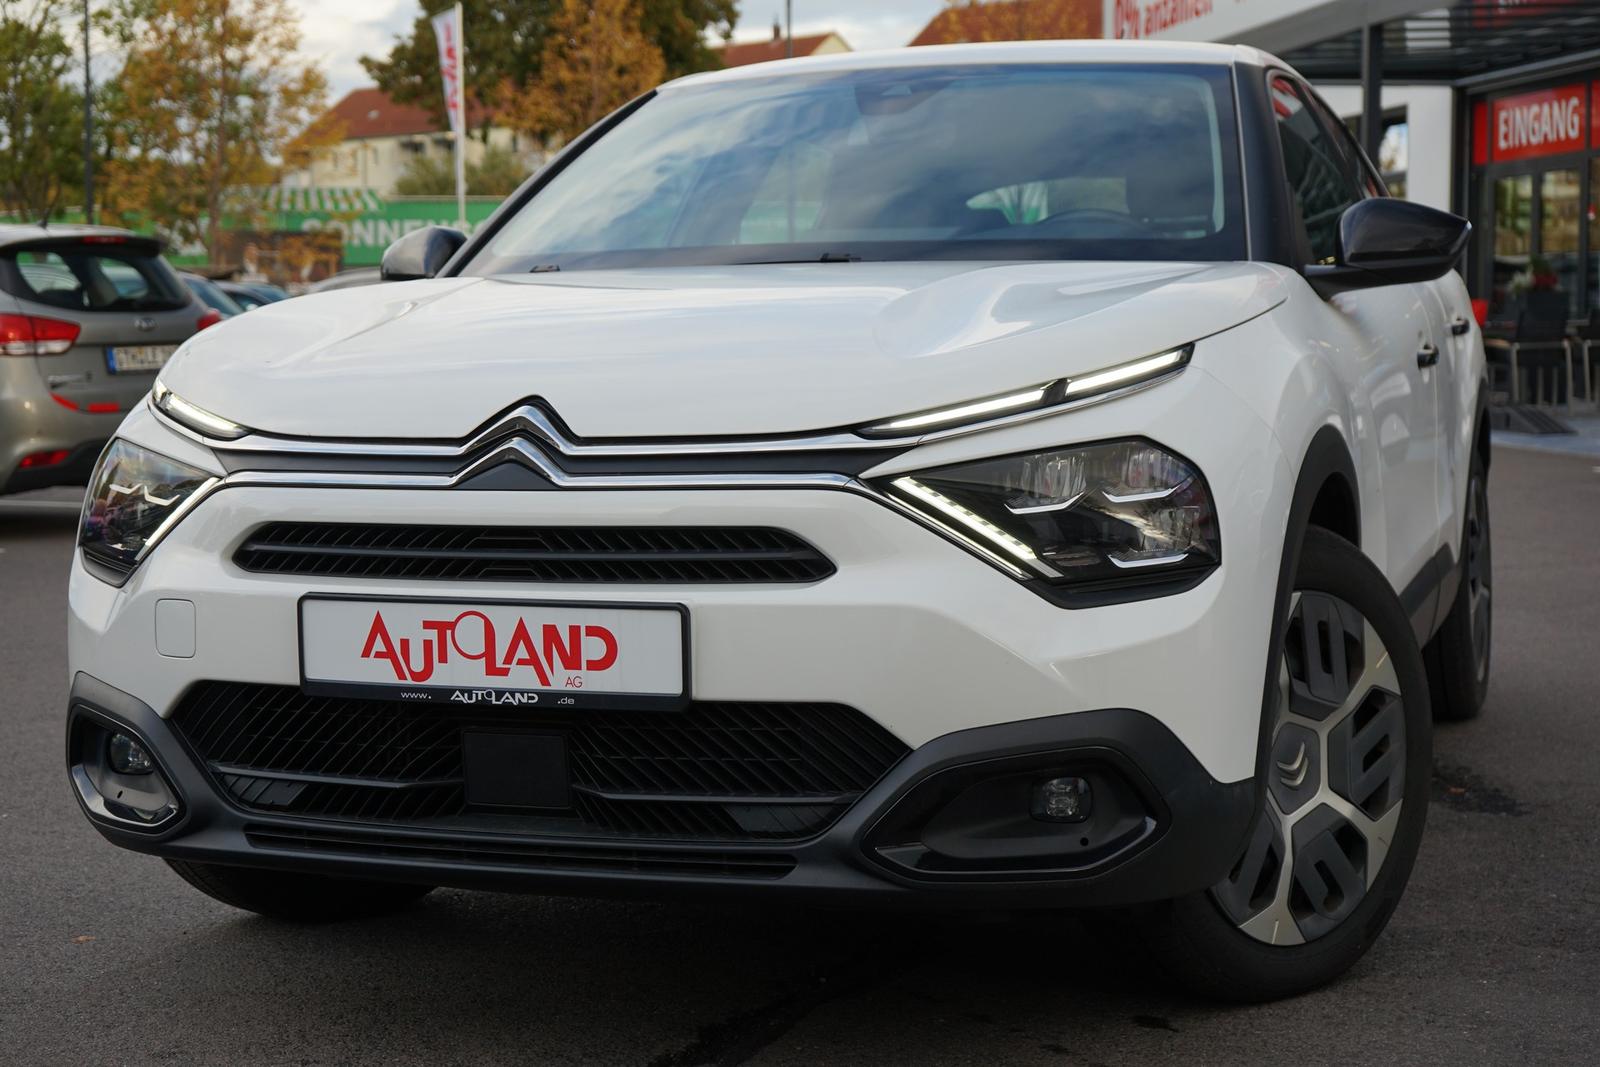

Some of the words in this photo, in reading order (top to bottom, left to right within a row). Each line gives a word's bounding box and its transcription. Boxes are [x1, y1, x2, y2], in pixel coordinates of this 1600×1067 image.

[1499, 96, 1579, 150] EINGANG
[361, 610, 618, 686] AUTOLAND
[401, 692, 432, 700] www.
[450, 689, 539, 705] AUTOLAND
[557, 696, 575, 705] .de
[565, 676, 583, 688] AG
